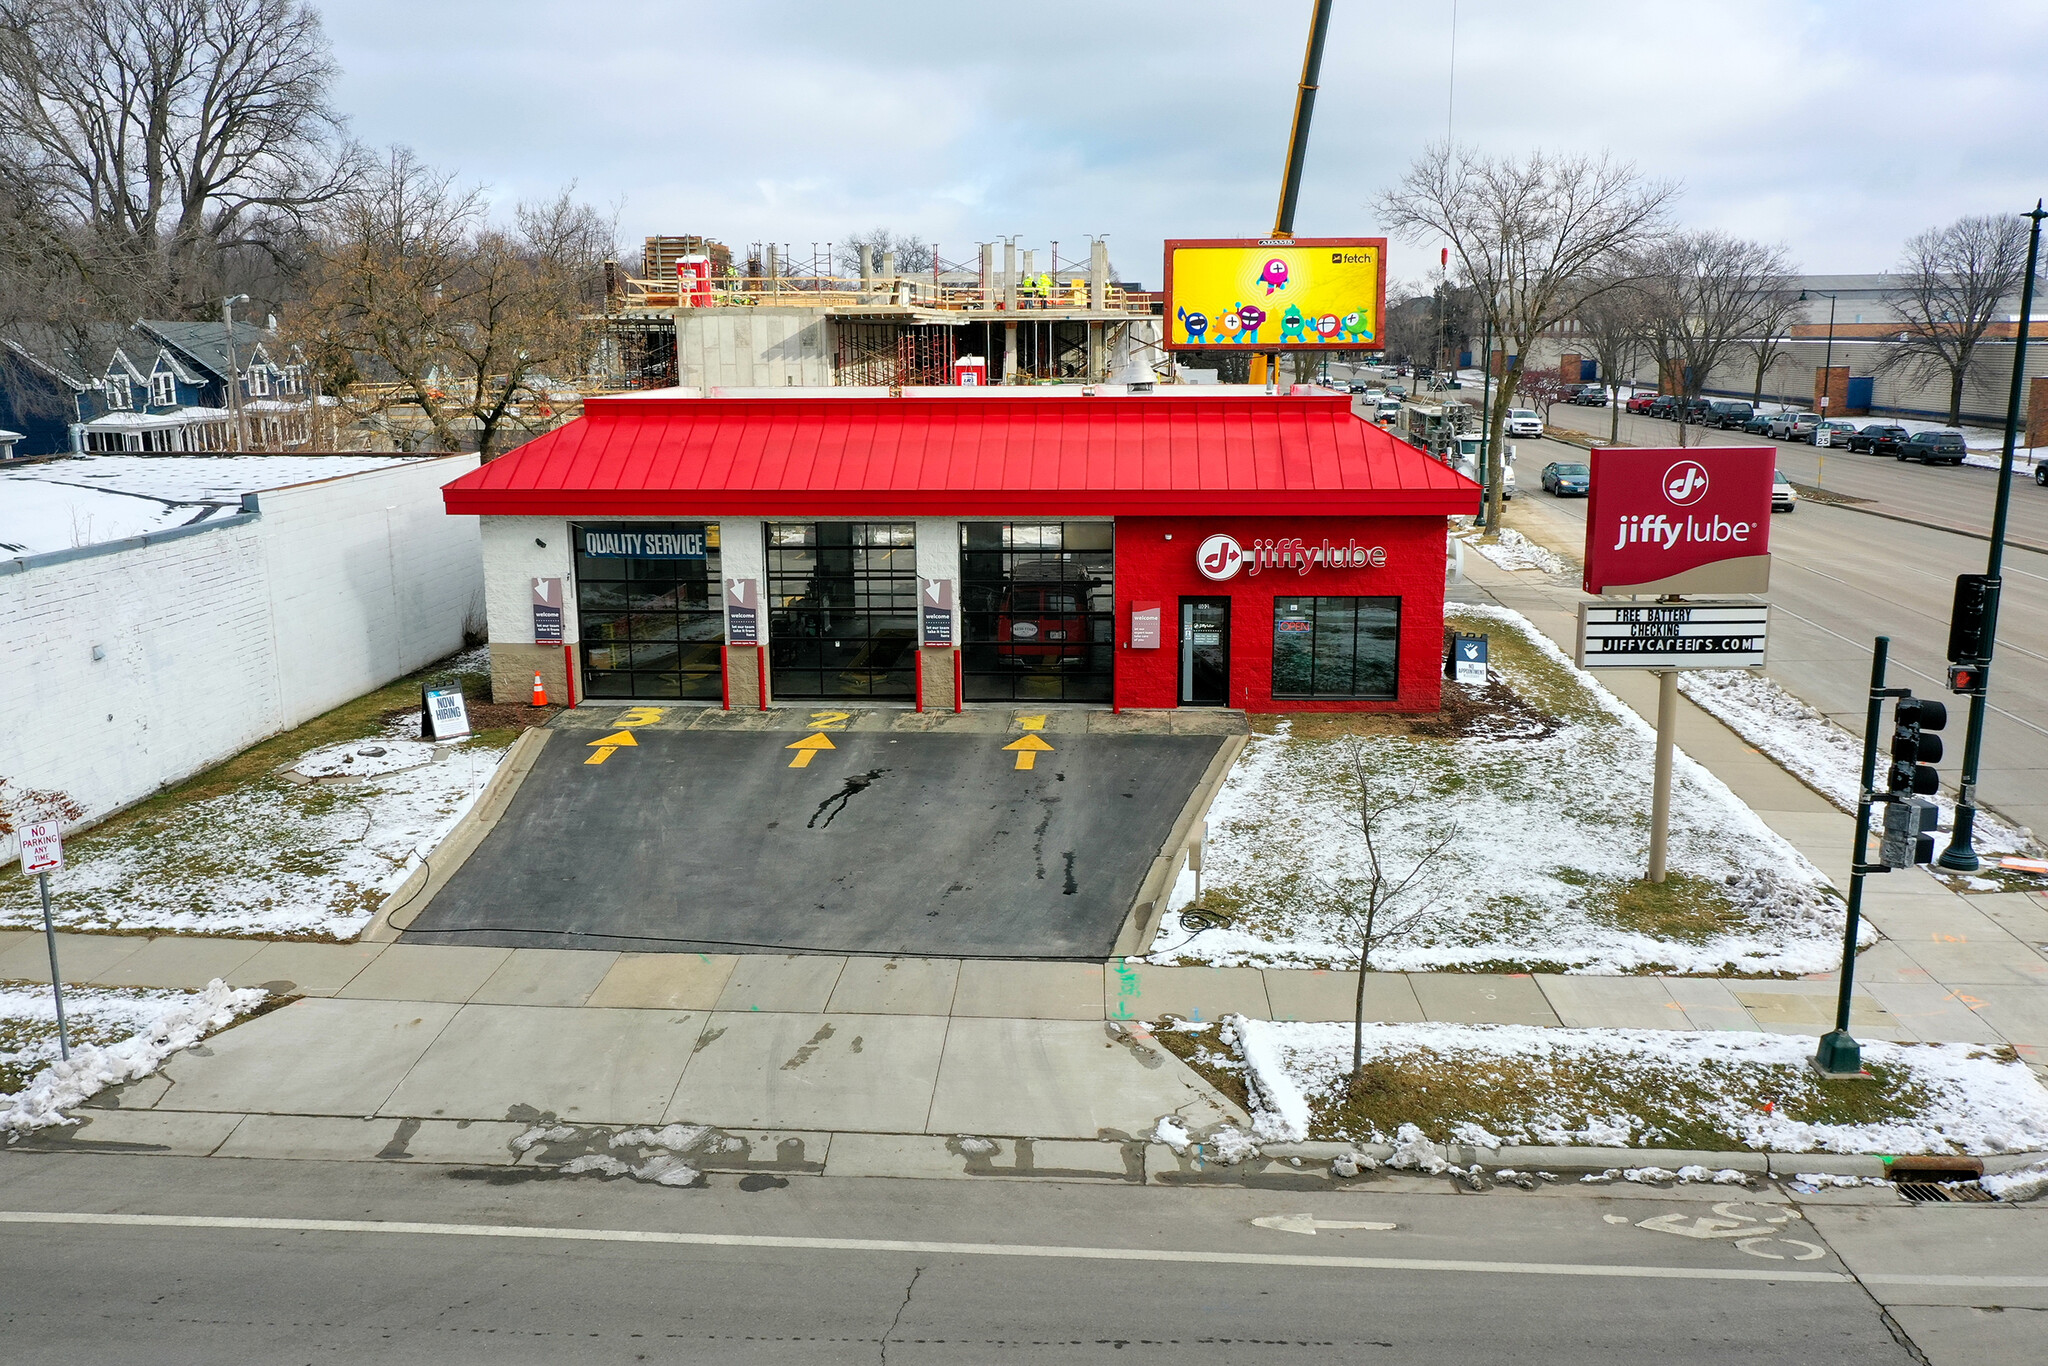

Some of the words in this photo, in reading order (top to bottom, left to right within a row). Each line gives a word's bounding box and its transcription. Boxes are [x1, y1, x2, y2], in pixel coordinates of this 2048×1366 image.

[1344, 253, 1371, 263] fetch
[1614, 515, 1683, 551] jiffy
[586, 533, 641, 556] QUALITY
[645, 534, 703, 555] SERVICE
[1249, 538, 1319, 577] jiffy
[1322, 538, 1387, 568] lube
[1616, 610, 1640, 622] FREE
[1648, 609, 1691, 622] BATTERY
[1280, 621, 1310, 632] OPEN
[1631, 624, 1679, 637] CHECKING
[436, 696, 454, 708] NOW
[436, 707, 461, 720] HIRING
[612, 707, 664, 727] 3
[806, 712, 850, 728] 2
[1015, 714, 1047, 731] 1
[31, 826, 46, 837] NO
[23, 835, 56, 848] PARKING
[34, 846, 47, 854] ANY
